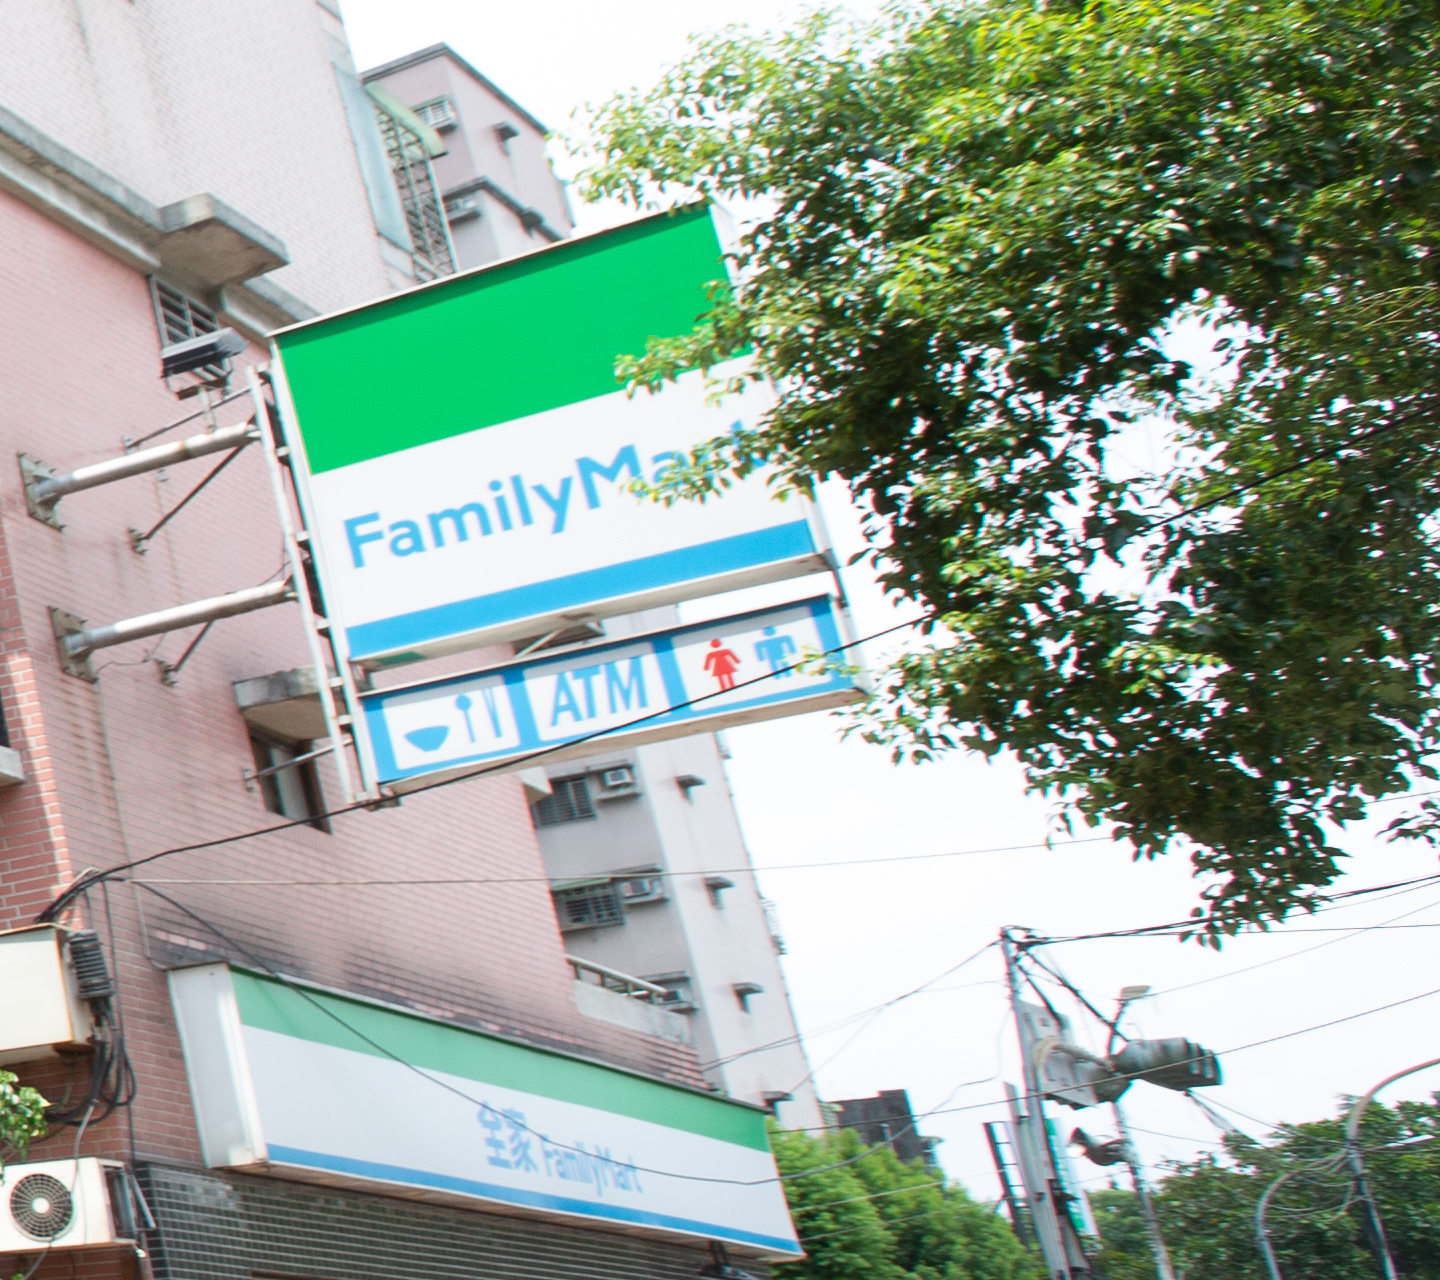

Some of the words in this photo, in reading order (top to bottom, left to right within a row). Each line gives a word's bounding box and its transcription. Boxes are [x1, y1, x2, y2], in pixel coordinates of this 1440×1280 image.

[550, 656, 649, 728] ATM
[477, 1101, 538, 1173] 全家
[541, 1134, 644, 1195] FamilyMart
